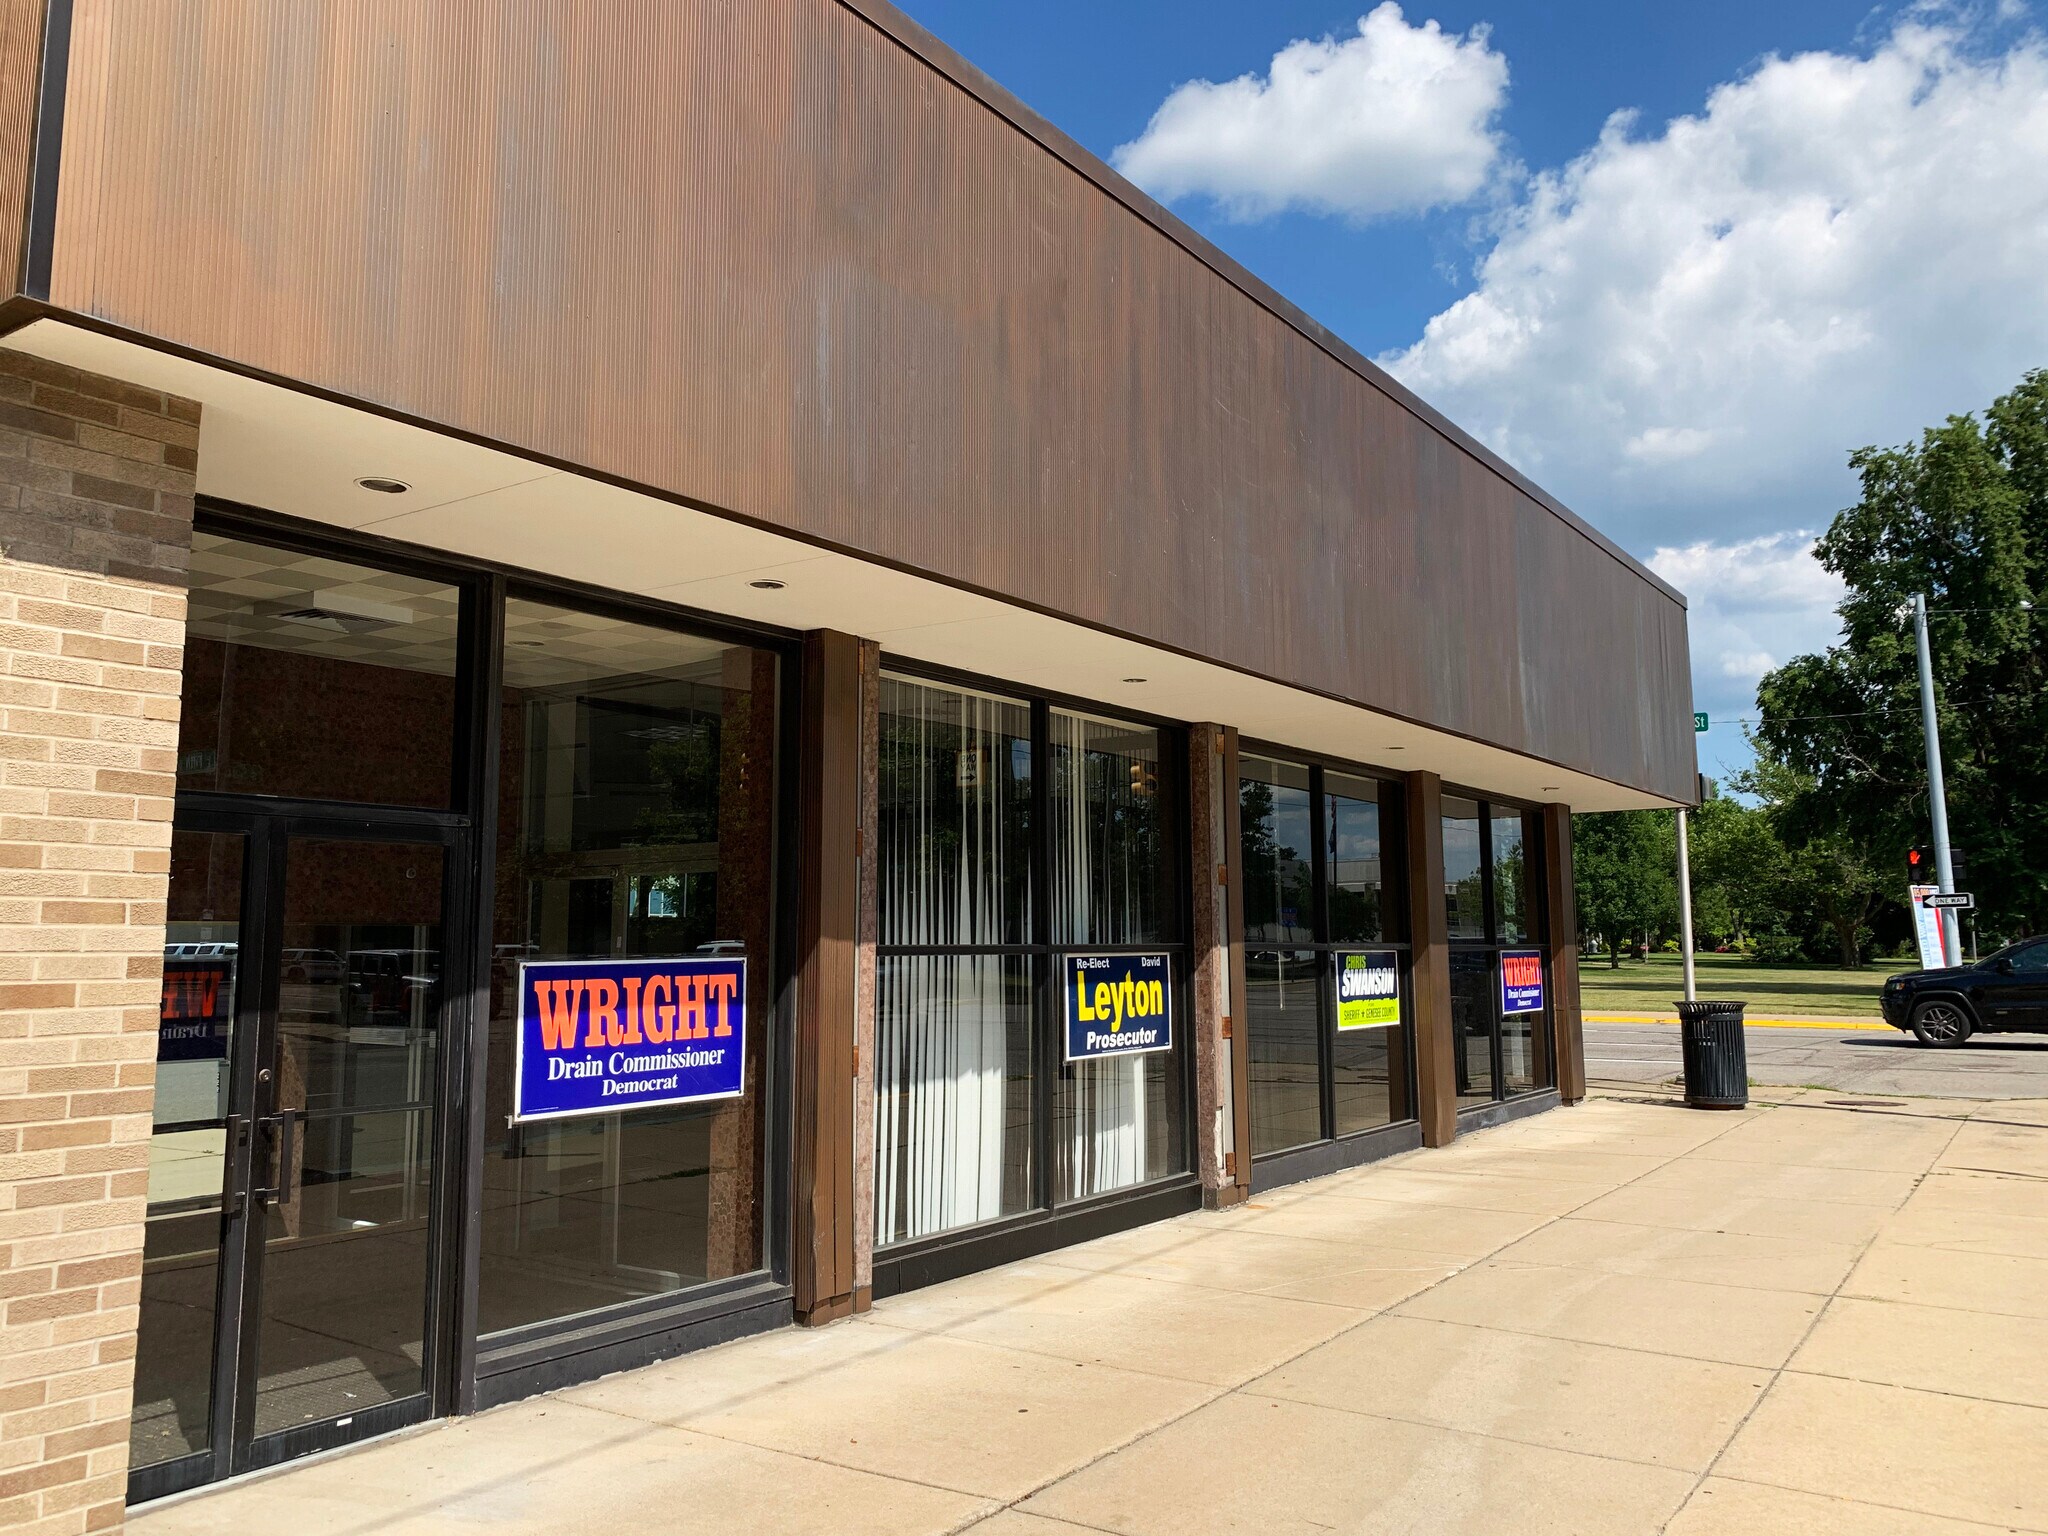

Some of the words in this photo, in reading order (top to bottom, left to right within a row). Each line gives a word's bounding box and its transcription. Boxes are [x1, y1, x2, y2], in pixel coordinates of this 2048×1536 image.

[1694, 716, 1705, 728] St
[1076, 958, 1110, 969] Re-Elect
[1141, 957, 1161, 967] David
[1346, 956, 1366, 969] CHRIS
[1503, 957, 1540, 986] WRIGHT
[1341, 967, 1395, 997] SWANSON
[534, 974, 737, 1050] WRIGHT
[1077, 969, 1163, 1032] Leyton
[1086, 1027, 1158, 1050] Prosecutor
[547, 1054, 603, 1081] Drain
[608, 1046, 725, 1075] Commissioner
[601, 1073, 679, 1096] Democrat
